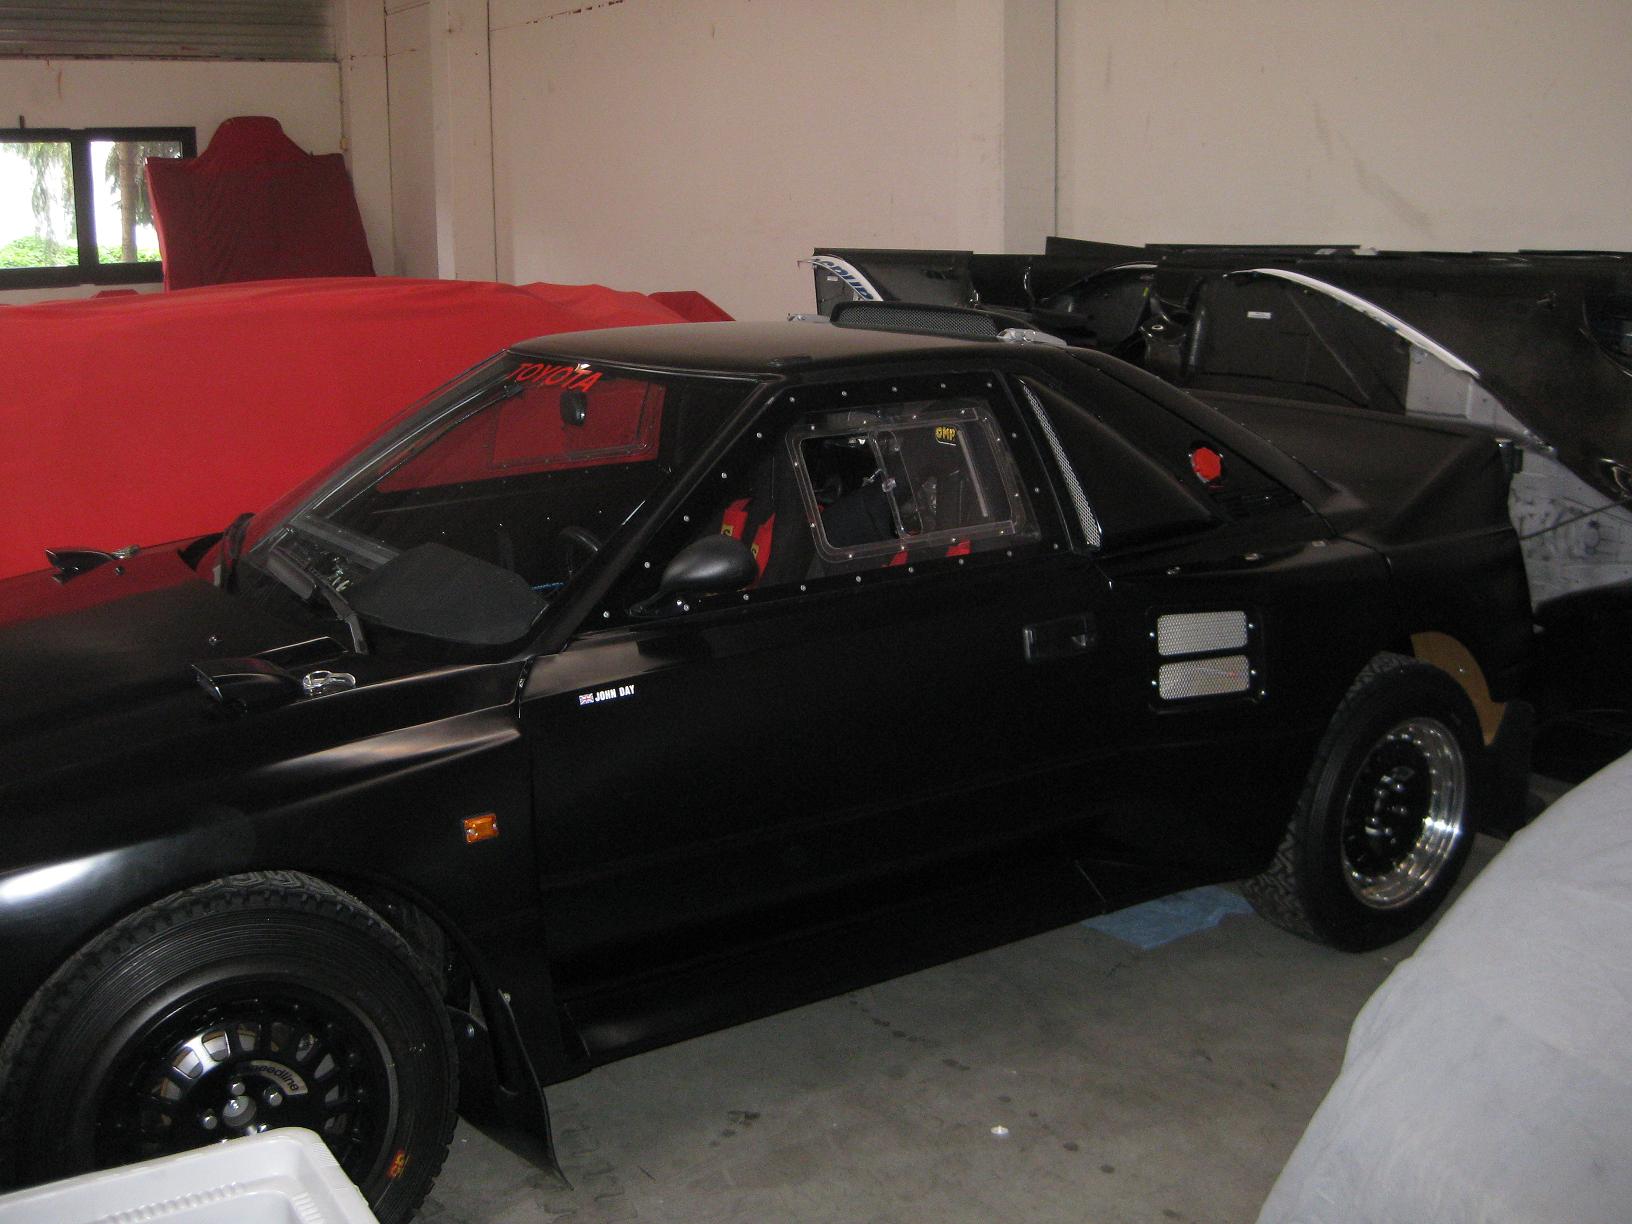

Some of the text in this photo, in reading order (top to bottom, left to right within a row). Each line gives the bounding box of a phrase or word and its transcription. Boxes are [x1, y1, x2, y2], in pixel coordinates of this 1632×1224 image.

[508, 363, 603, 392] TOYOTA
[595, 684, 635, 702] JOHN DAY
